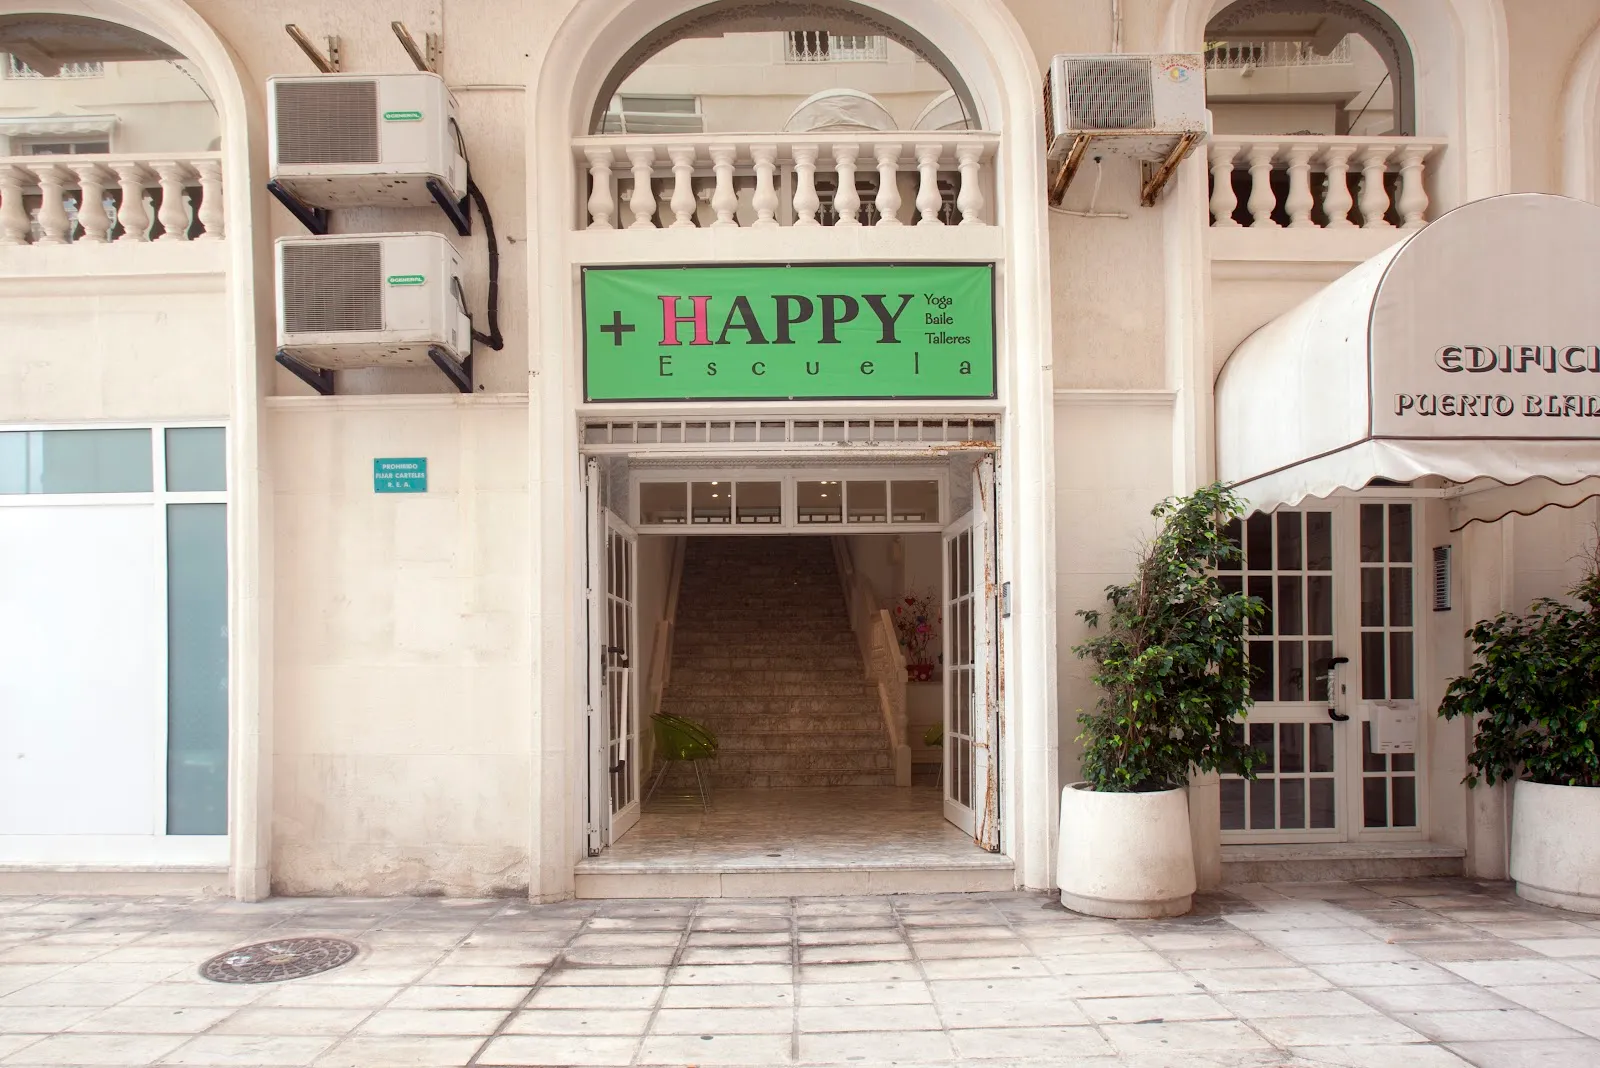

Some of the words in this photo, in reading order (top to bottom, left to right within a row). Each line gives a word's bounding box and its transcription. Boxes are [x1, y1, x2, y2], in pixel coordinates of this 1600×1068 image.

[923, 293, 953, 308] Yoga
[657, 294, 915, 347] HAPPY
[925, 312, 954, 326] Baile
[924, 332, 971, 346] Talleres
[659, 351, 972, 377] Escuela
[1434, 344, 1600, 373] EDIFICI
[1393, 393, 1515, 417] PUERTO
